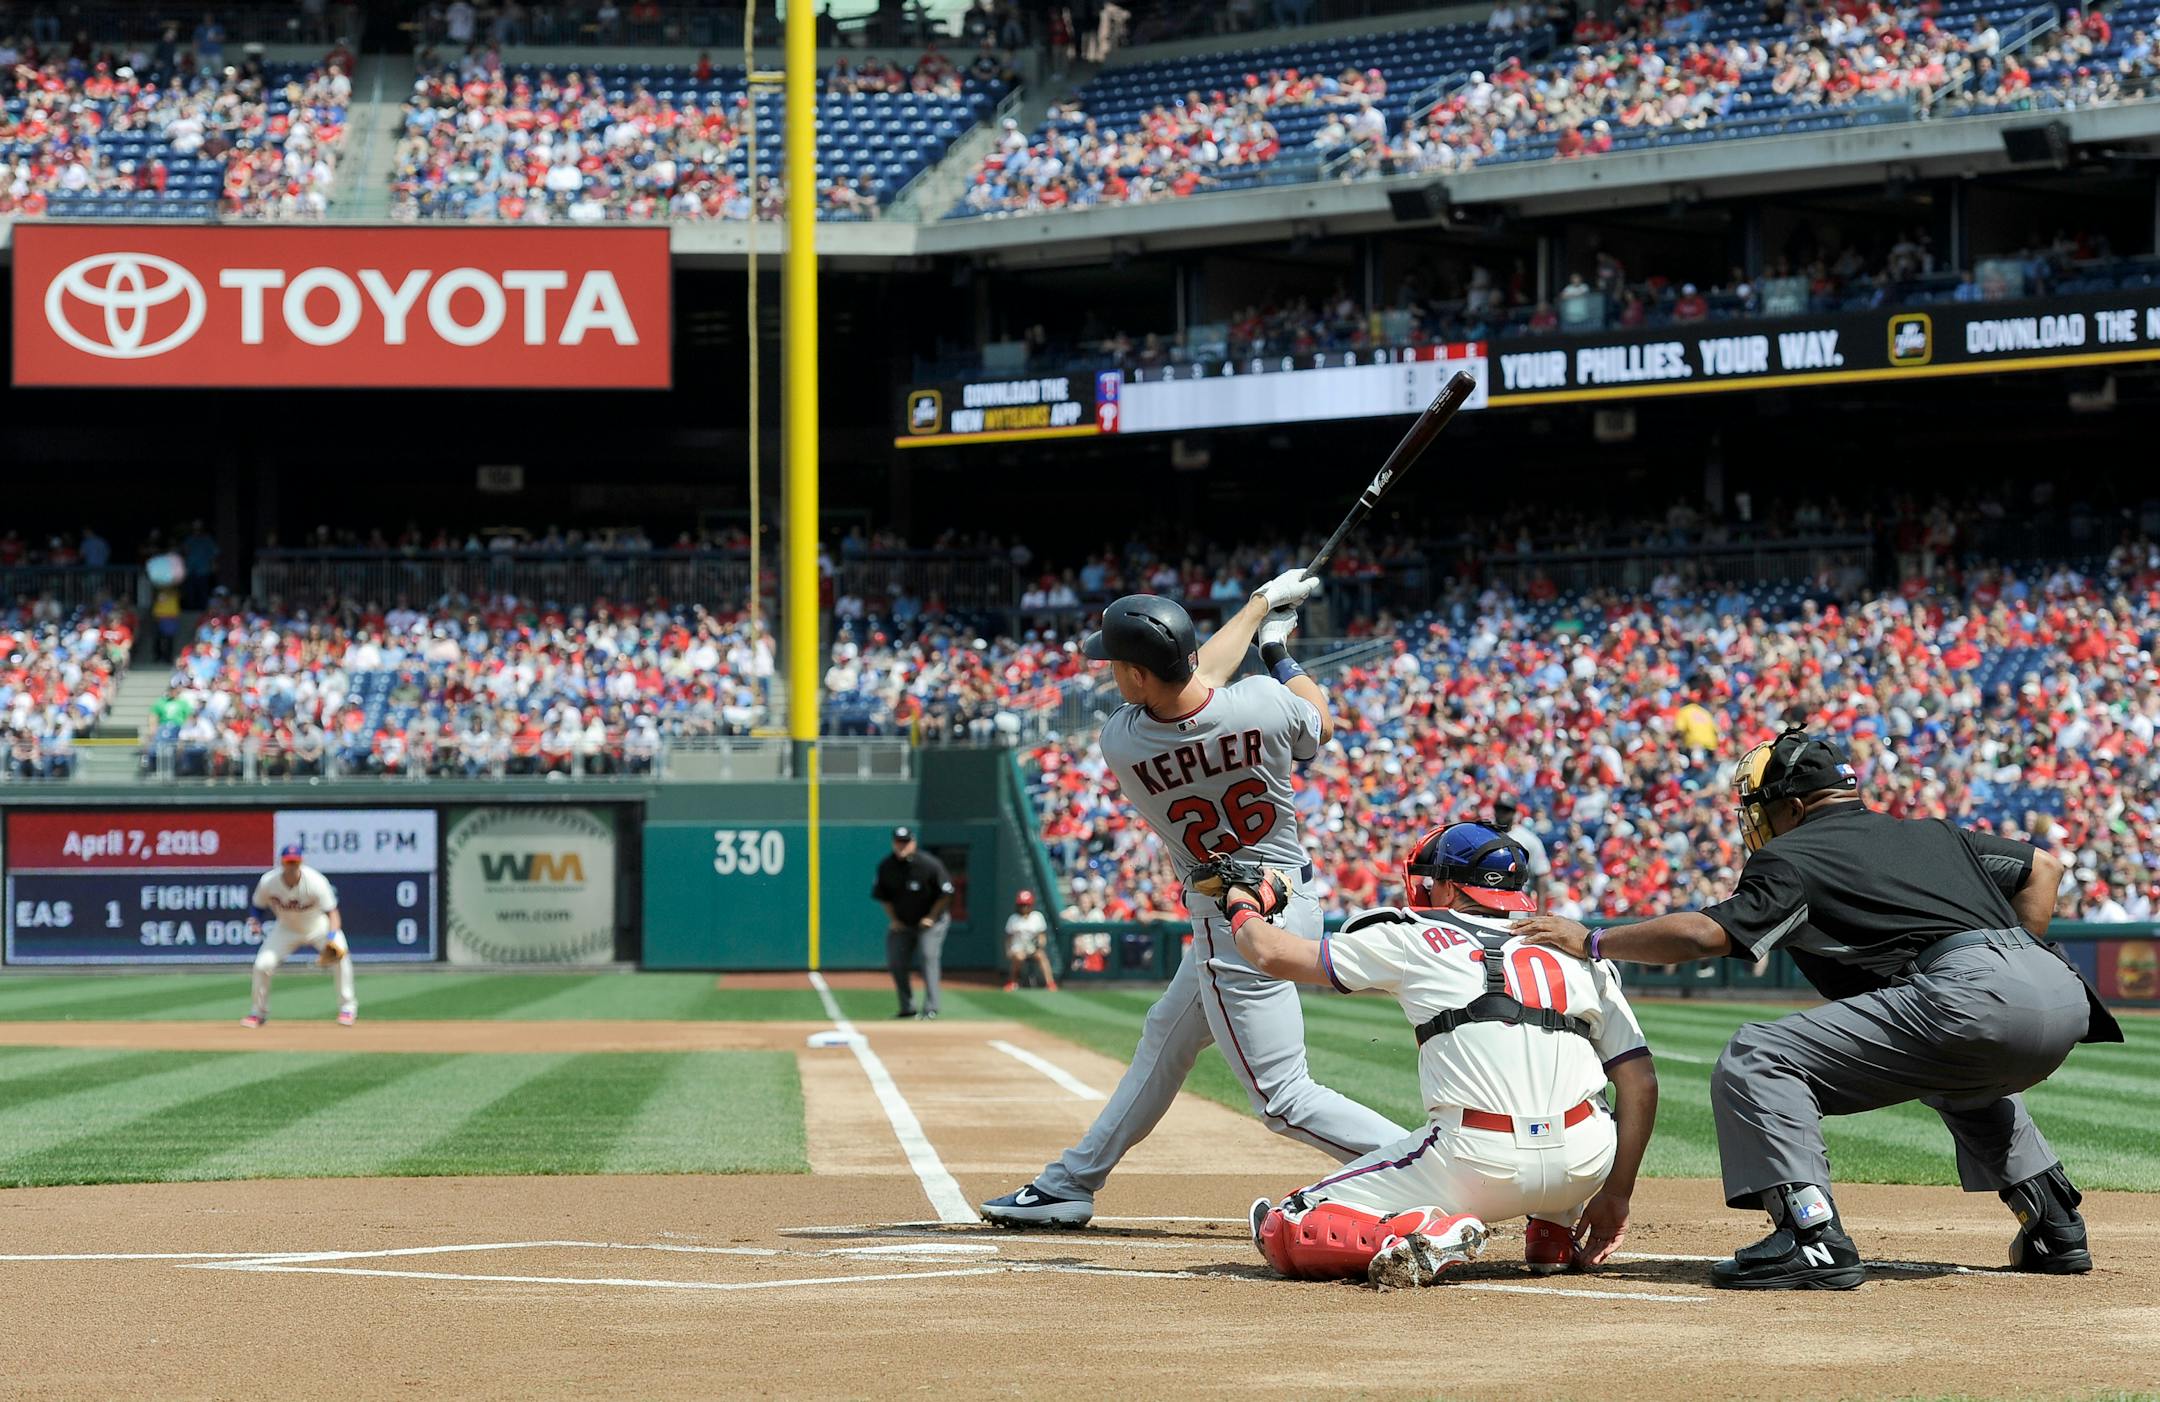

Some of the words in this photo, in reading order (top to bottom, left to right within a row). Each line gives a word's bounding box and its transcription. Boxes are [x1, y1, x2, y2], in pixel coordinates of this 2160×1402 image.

[219, 267, 639, 346] TOYOTA
[1966, 313, 2086, 354] DOWNLOAD
[2095, 309, 2139, 345] THE
[1500, 351, 1567, 390] YOUR
[1577, 342, 1693, 385] PHILLIES.
[1699, 335, 1769, 375] YOUR
[1778, 329, 1844, 370] WAY.
[1041, 377, 1069, 401] THE
[1132, 728, 1264, 796] KEPLER
[1167, 777, 1278, 864] 26
[63, 830, 124, 861] April
[128, 830, 152, 859] 7,
[156, 830, 219, 855] 2019
[299, 829, 360, 854] 1:08
[375, 830, 418, 850] PM
[713, 830, 786, 875] 330
[479, 853, 587, 882] WM
[141, 885, 249, 910] FIGHTIN
[396, 881, 418, 907] 0
[16, 901, 73, 927] EAS
[105, 901, 124, 927] 1
[140, 920, 196, 946] SEA
[397, 918, 418, 945] 0
